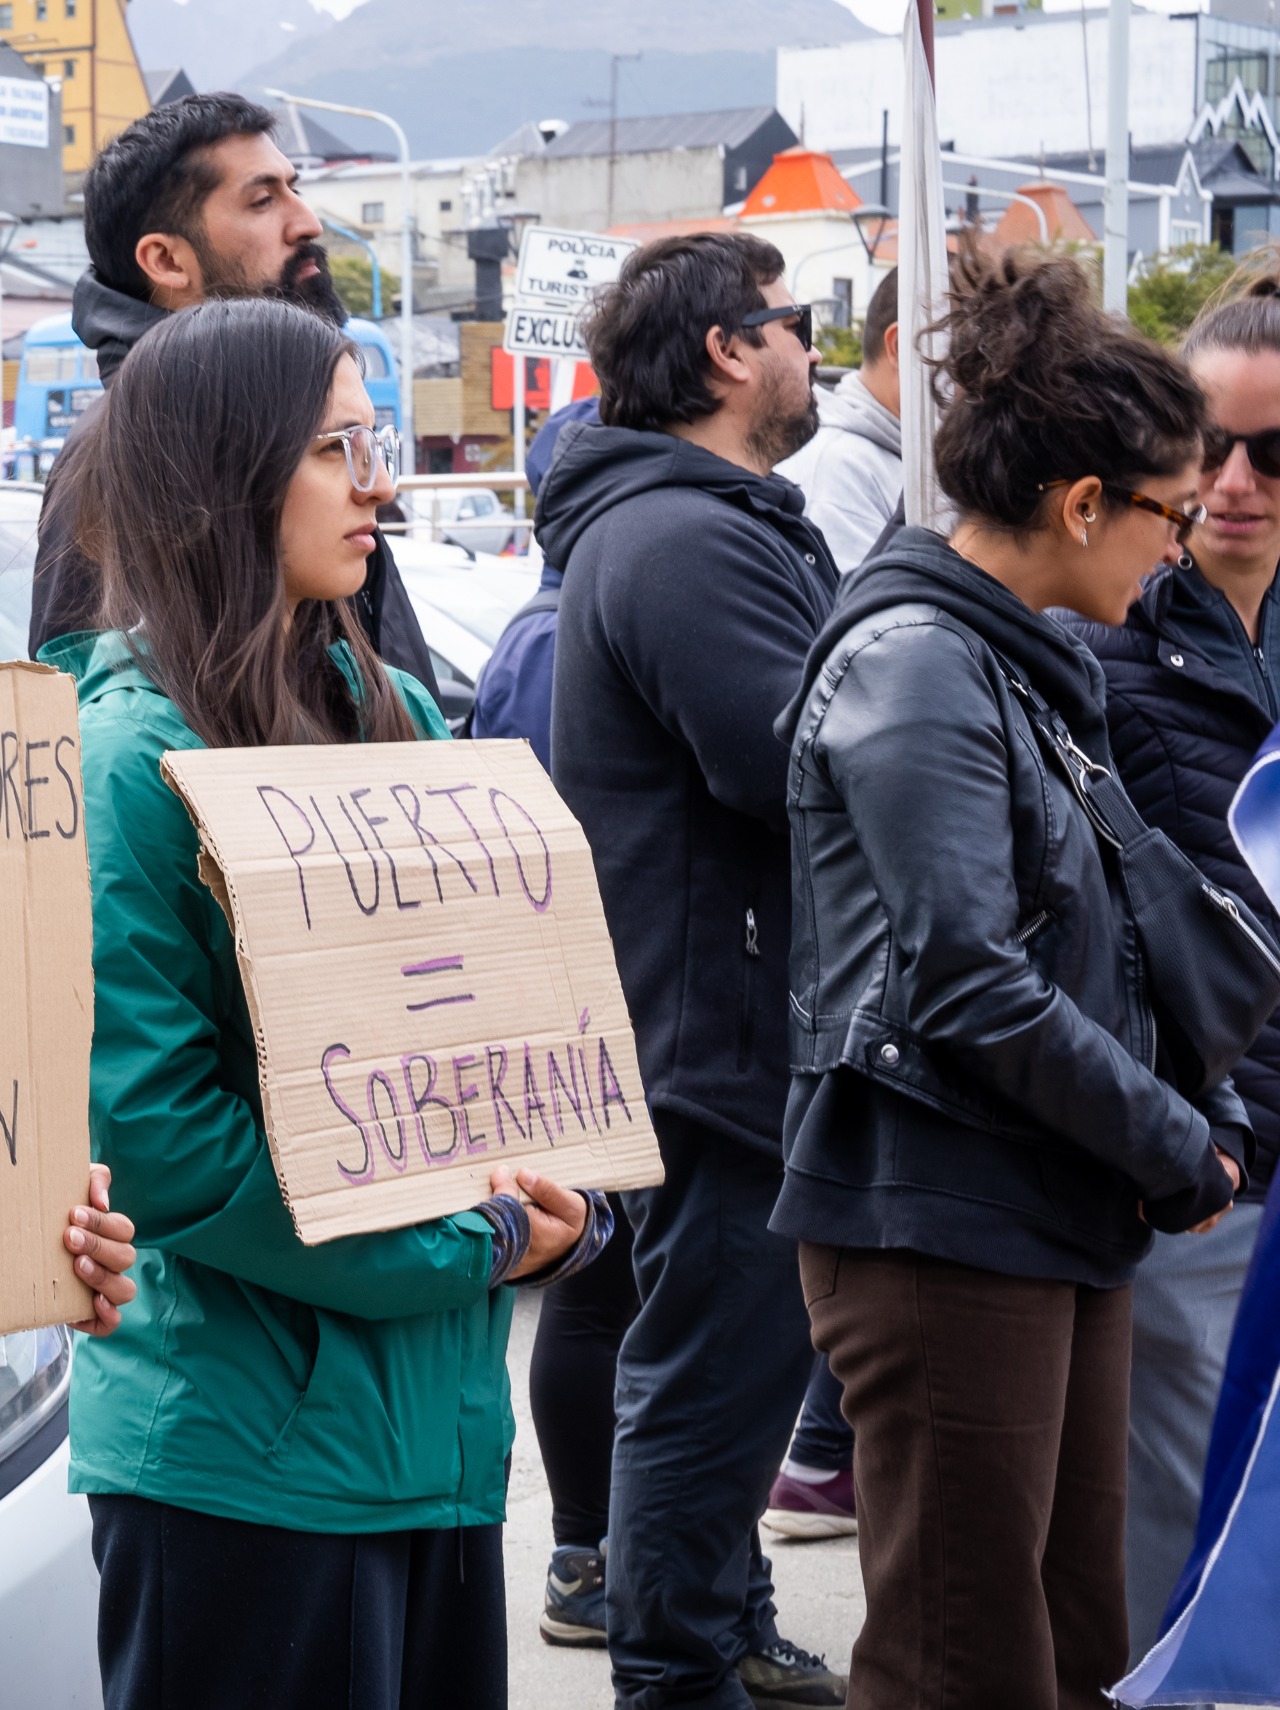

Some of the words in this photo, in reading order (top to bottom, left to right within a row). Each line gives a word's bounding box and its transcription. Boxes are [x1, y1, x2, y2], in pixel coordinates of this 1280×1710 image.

[514, 315, 584, 350] EXCLU
[256, 783, 552, 931] PUERTO
[320, 1007, 633, 1186] SOBERANÍA
